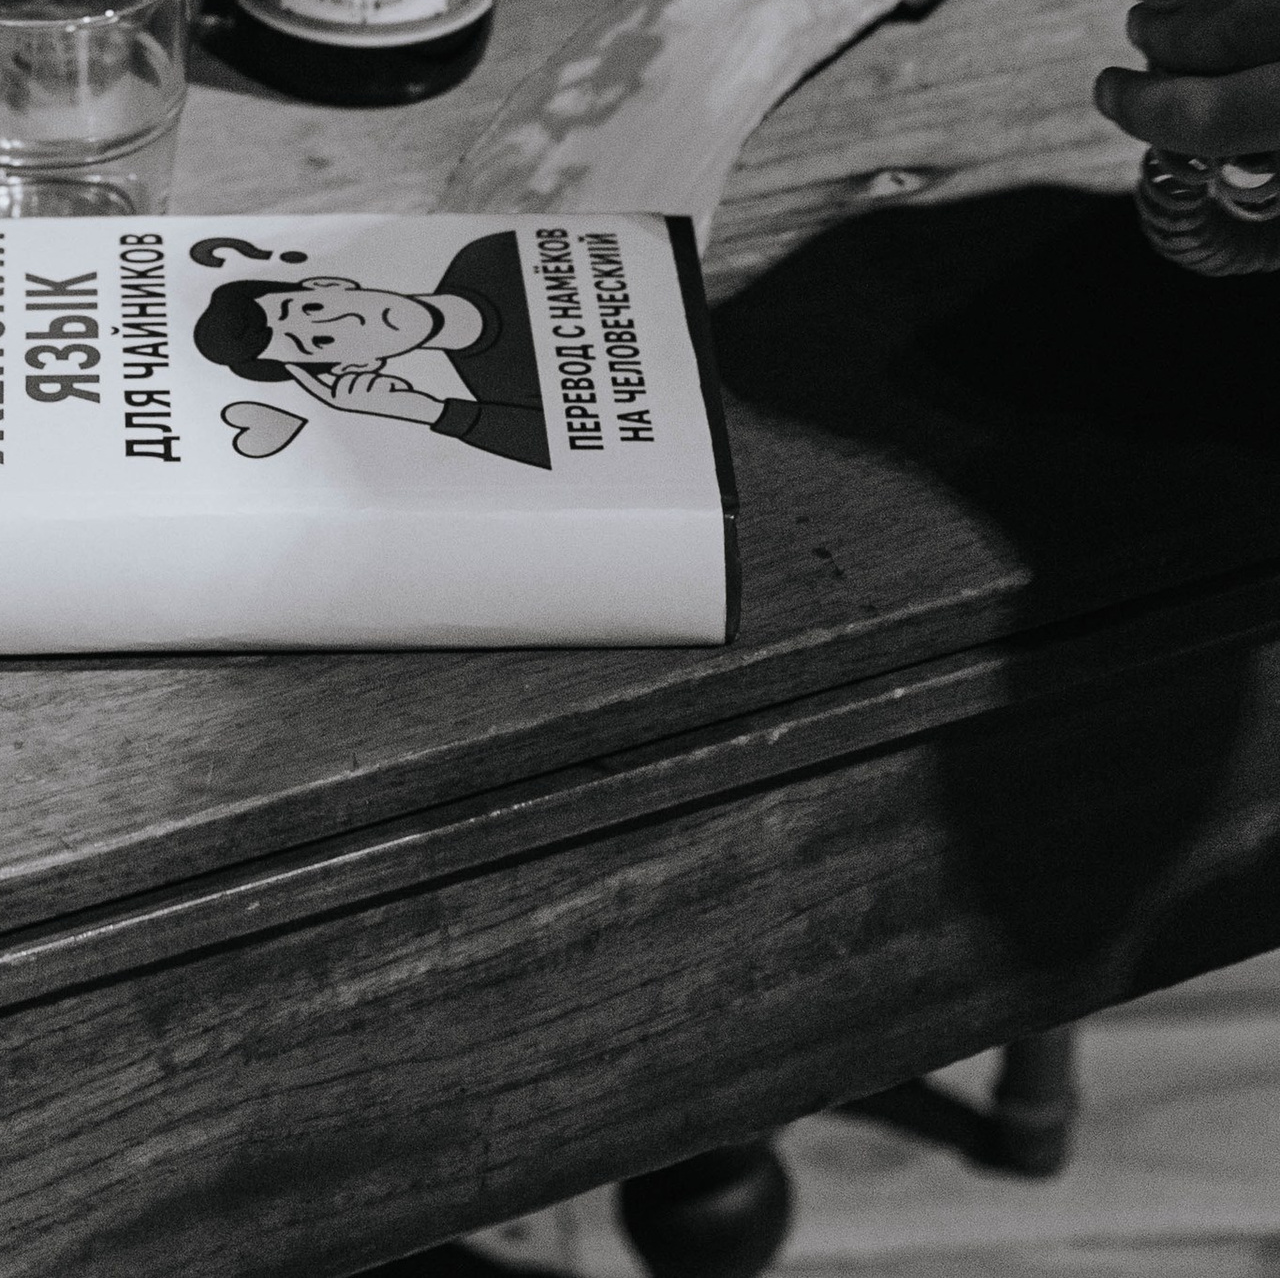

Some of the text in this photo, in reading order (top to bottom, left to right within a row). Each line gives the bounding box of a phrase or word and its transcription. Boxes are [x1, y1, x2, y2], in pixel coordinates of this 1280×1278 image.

[24, 271, 101, 404] ЯЗЫК
[110, 233, 181, 462] ДЛЯ ЧАЙНИКОВ
[533, 228, 604, 450] ПЕРЕВОД С НАМЁКОВ
[617, 409, 654, 442] НА
